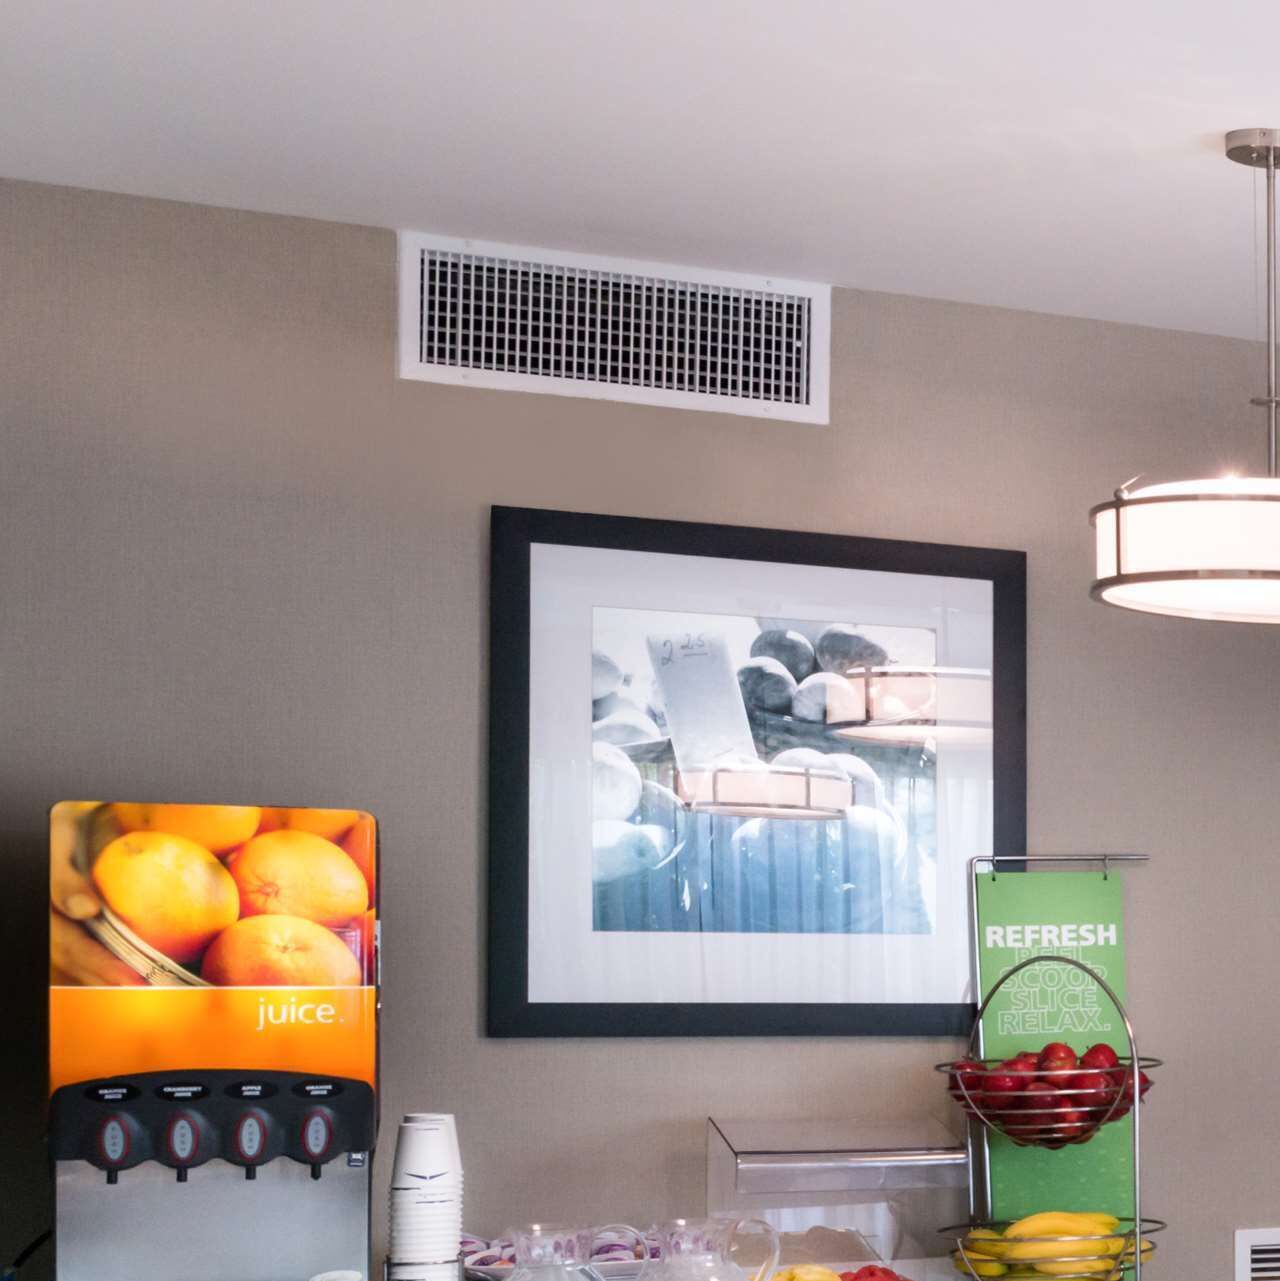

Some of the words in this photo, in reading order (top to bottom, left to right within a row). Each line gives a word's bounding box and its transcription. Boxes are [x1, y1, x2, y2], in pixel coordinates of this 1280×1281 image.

[985, 923, 1117, 948] REFRESH
[1000, 964, 1108, 991] SCOOP
[1011, 987, 1097, 1012] SLICE
[998, 1008, 1112, 1035] RELAX.
